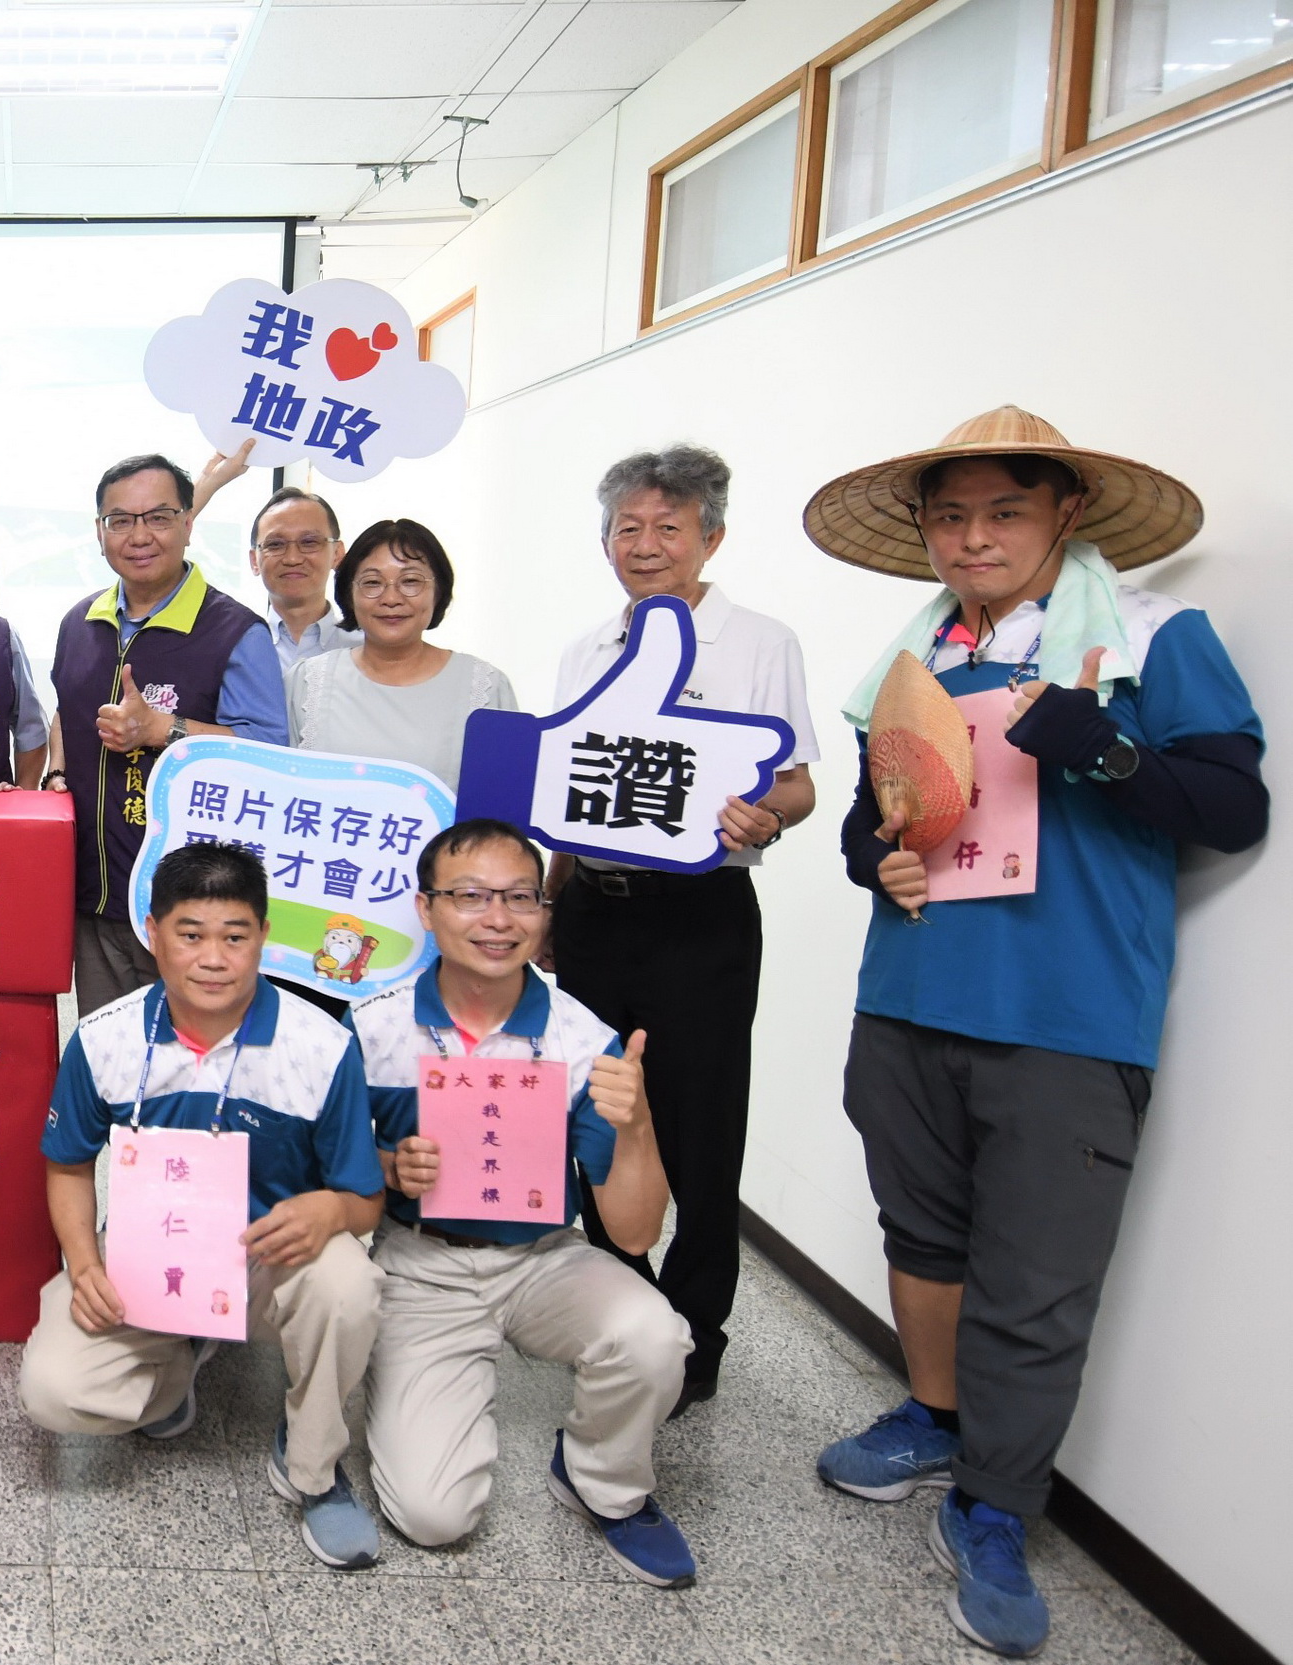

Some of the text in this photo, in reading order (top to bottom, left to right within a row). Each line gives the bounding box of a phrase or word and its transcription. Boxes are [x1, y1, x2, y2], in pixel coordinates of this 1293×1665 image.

[241, 299, 314, 371] 我
[231, 372, 381, 467] 地政
[682, 688, 703, 701] FILA
[187, 780, 424, 857] 照片保存好
[565, 731, 697, 838] 讚
[454, 1072, 540, 1090] 大家好
[480, 1102, 502, 1204] 我是界標
